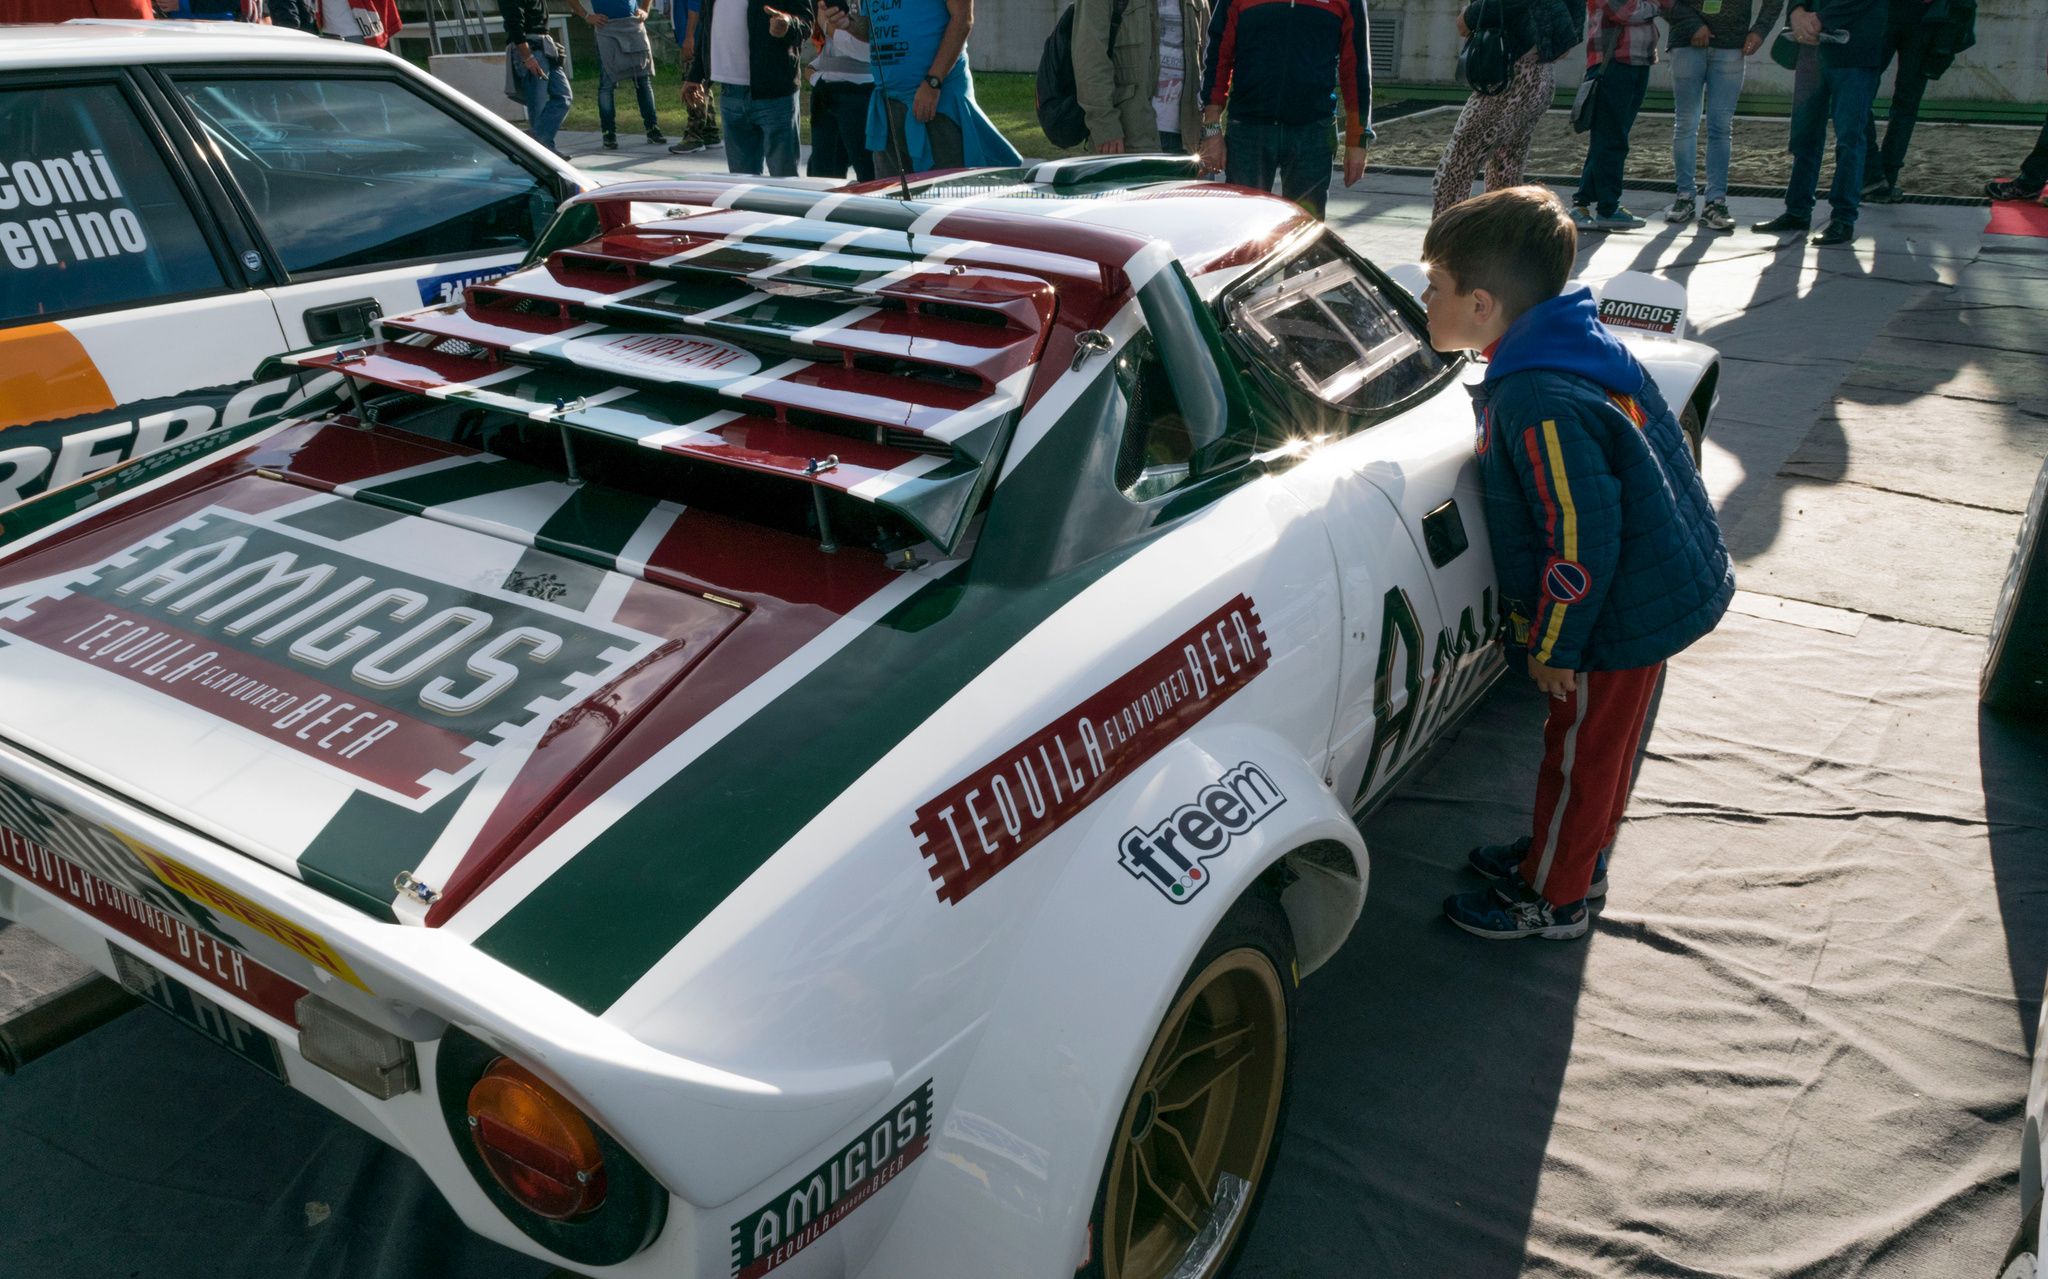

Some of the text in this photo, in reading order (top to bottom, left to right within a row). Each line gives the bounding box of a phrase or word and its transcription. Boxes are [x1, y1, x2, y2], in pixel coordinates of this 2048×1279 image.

[873, 25, 899, 39] RIVE
[1603, 301, 1675, 324] AMIGOS
[63, 613, 399, 759] TEQUILA FLAVOURED BEER
[115, 536, 563, 716] AMIGOS
[938, 609, 1256, 871] TEQUILA FLAVOURED BEER
[1126, 762, 1280, 889] freem
[97, 877, 173, 938] FLAVOURED
[176, 922, 248, 991] BEER
[753, 1100, 918, 1259] AMIGOS
[767, 1154, 904, 1270] TEQUILA FLAVOURED BEER
